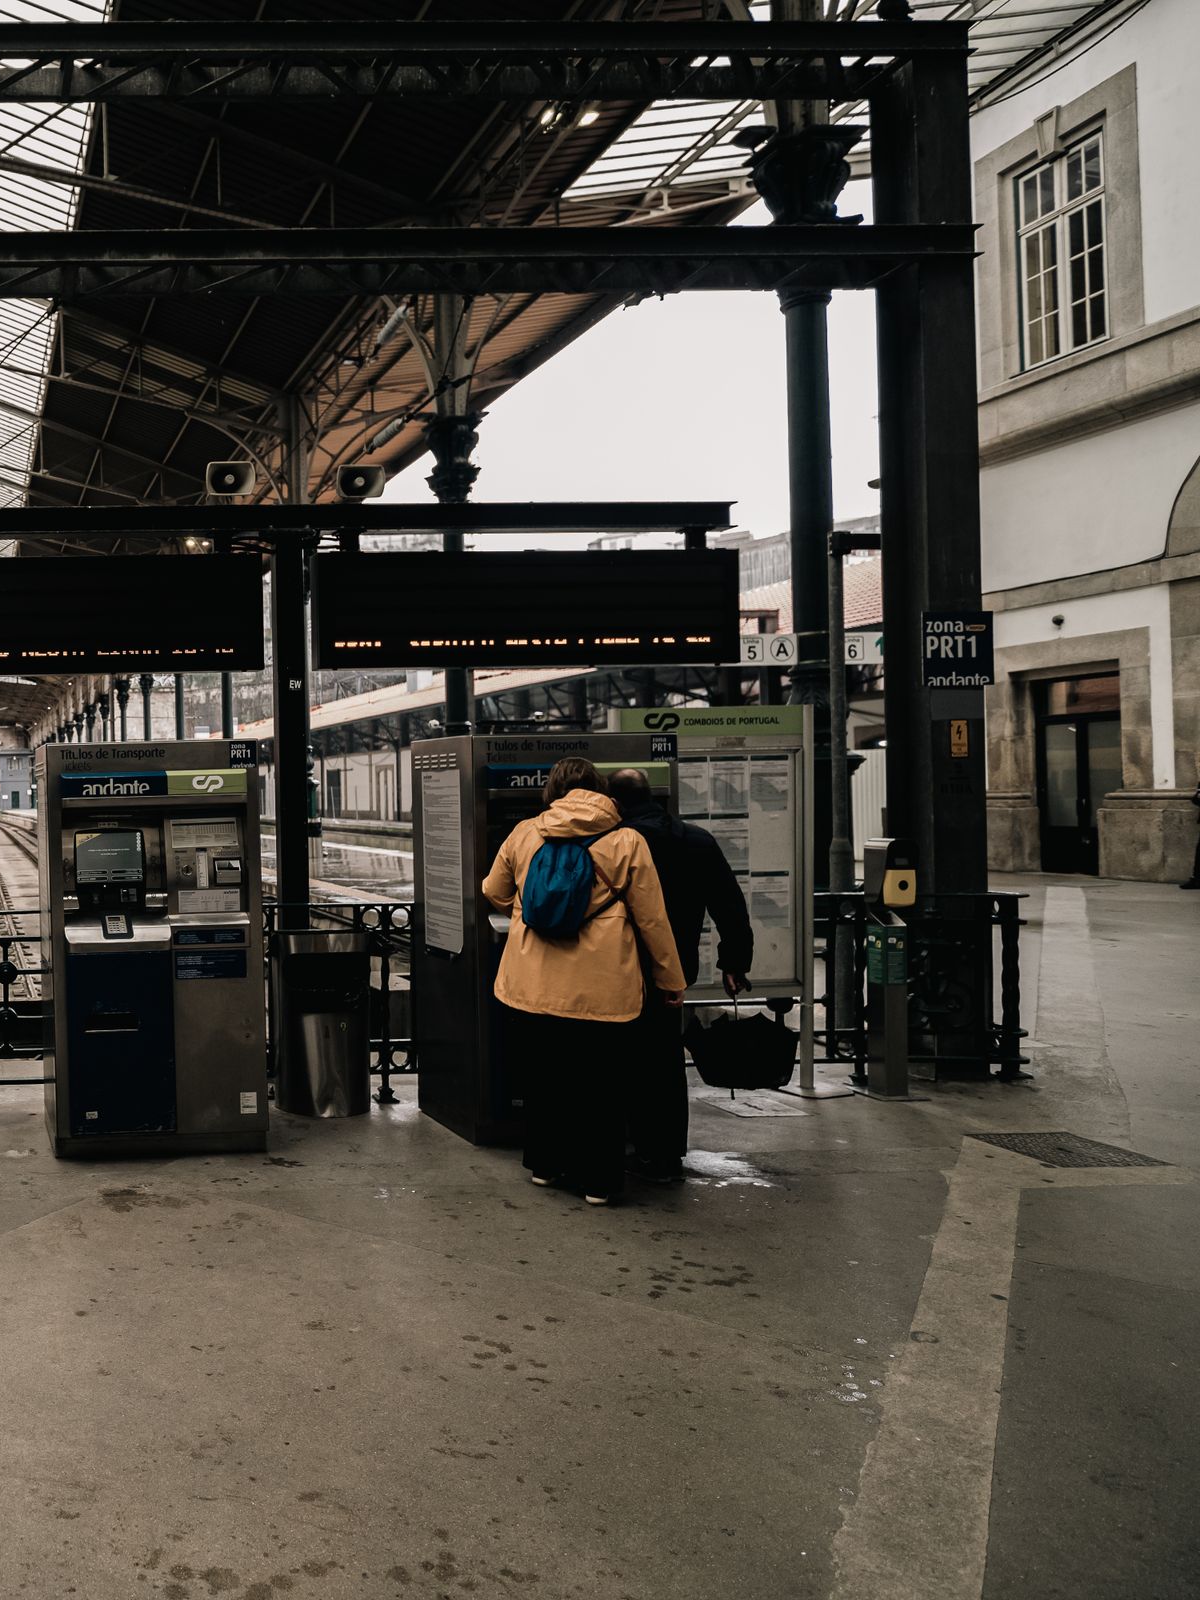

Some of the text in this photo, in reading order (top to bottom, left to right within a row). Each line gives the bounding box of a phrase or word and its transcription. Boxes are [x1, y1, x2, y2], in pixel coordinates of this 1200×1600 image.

[926, 620, 964, 633] zona
[748, 643, 857, 660] 5 A 6
[926, 635, 977, 659] PRT1
[928, 671, 990, 686] andante
[684, 718, 724, 726] COMBOIOS
[727, 717, 736, 725] DE
[739, 716, 780, 725] PORTUGAL
[521, 739, 534, 751] de
[537, 740, 589, 752] Transporte
[652, 742, 671, 752] PRT1
[96, 748, 109, 760] de
[112, 748, 165, 760] Transporte
[231, 749, 250, 758] PRT1
[65, 761, 92, 771] ickets
[510, 769, 550, 787] anda
[82, 778, 150, 795] andante
